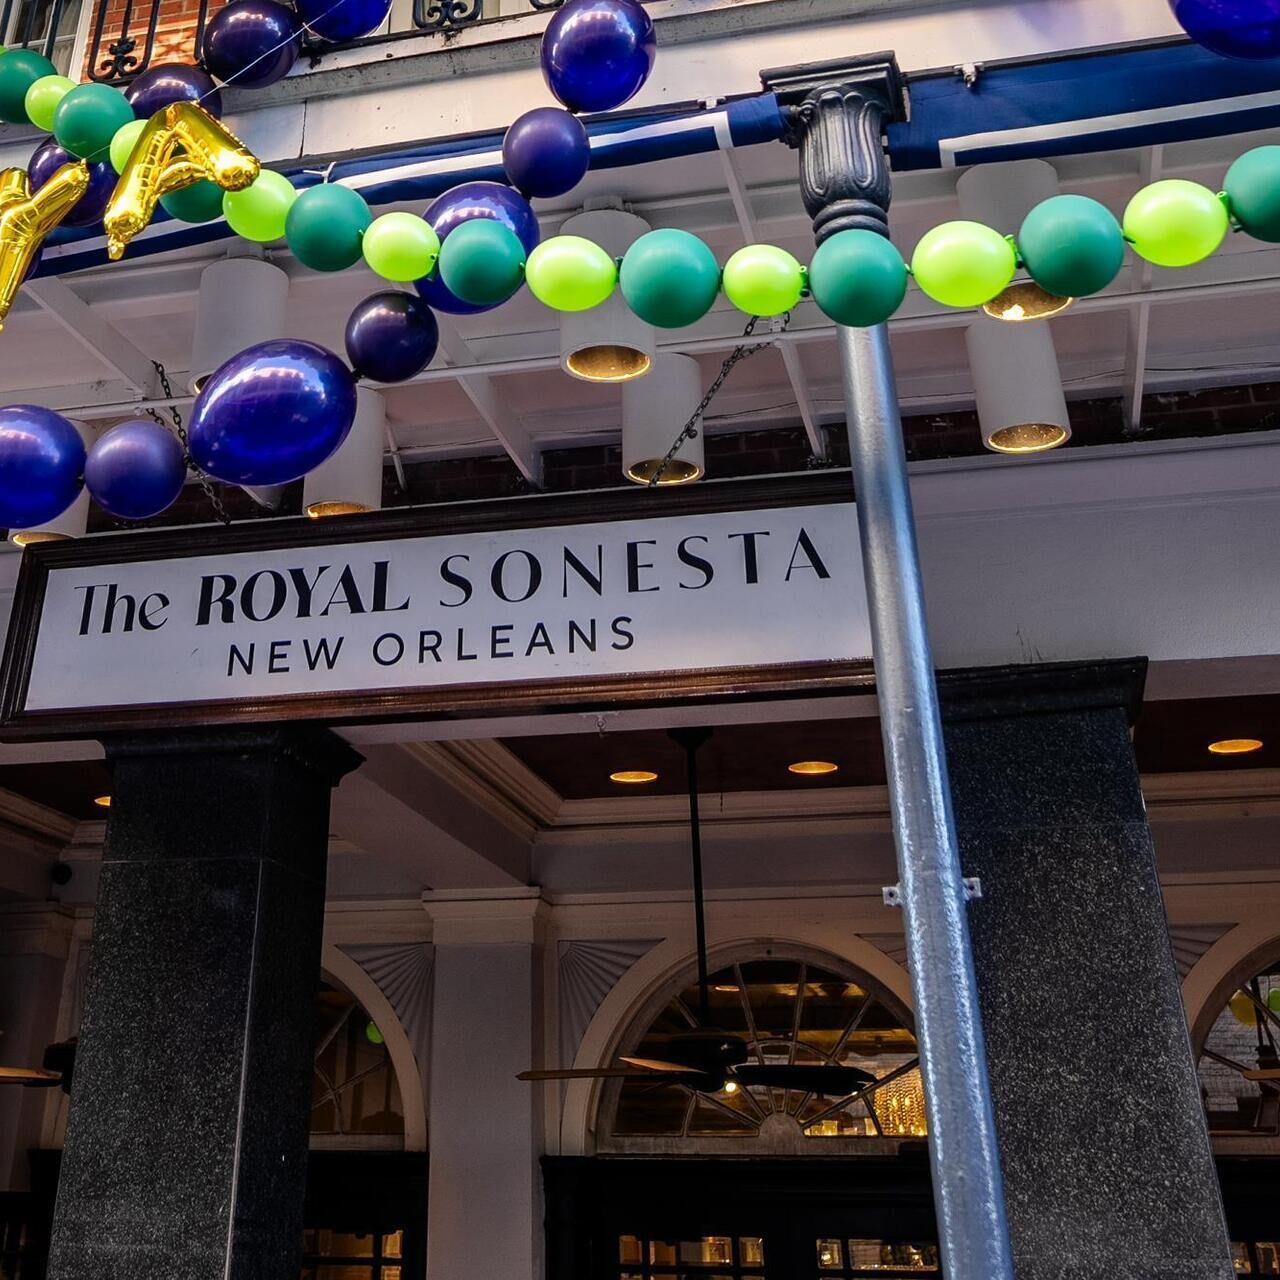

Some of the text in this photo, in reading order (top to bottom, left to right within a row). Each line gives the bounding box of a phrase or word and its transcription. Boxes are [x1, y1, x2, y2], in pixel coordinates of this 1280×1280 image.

[73, 527, 833, 636] The ROYAL SONESTA
[227, 615, 636, 678] NEW ORLEANS
